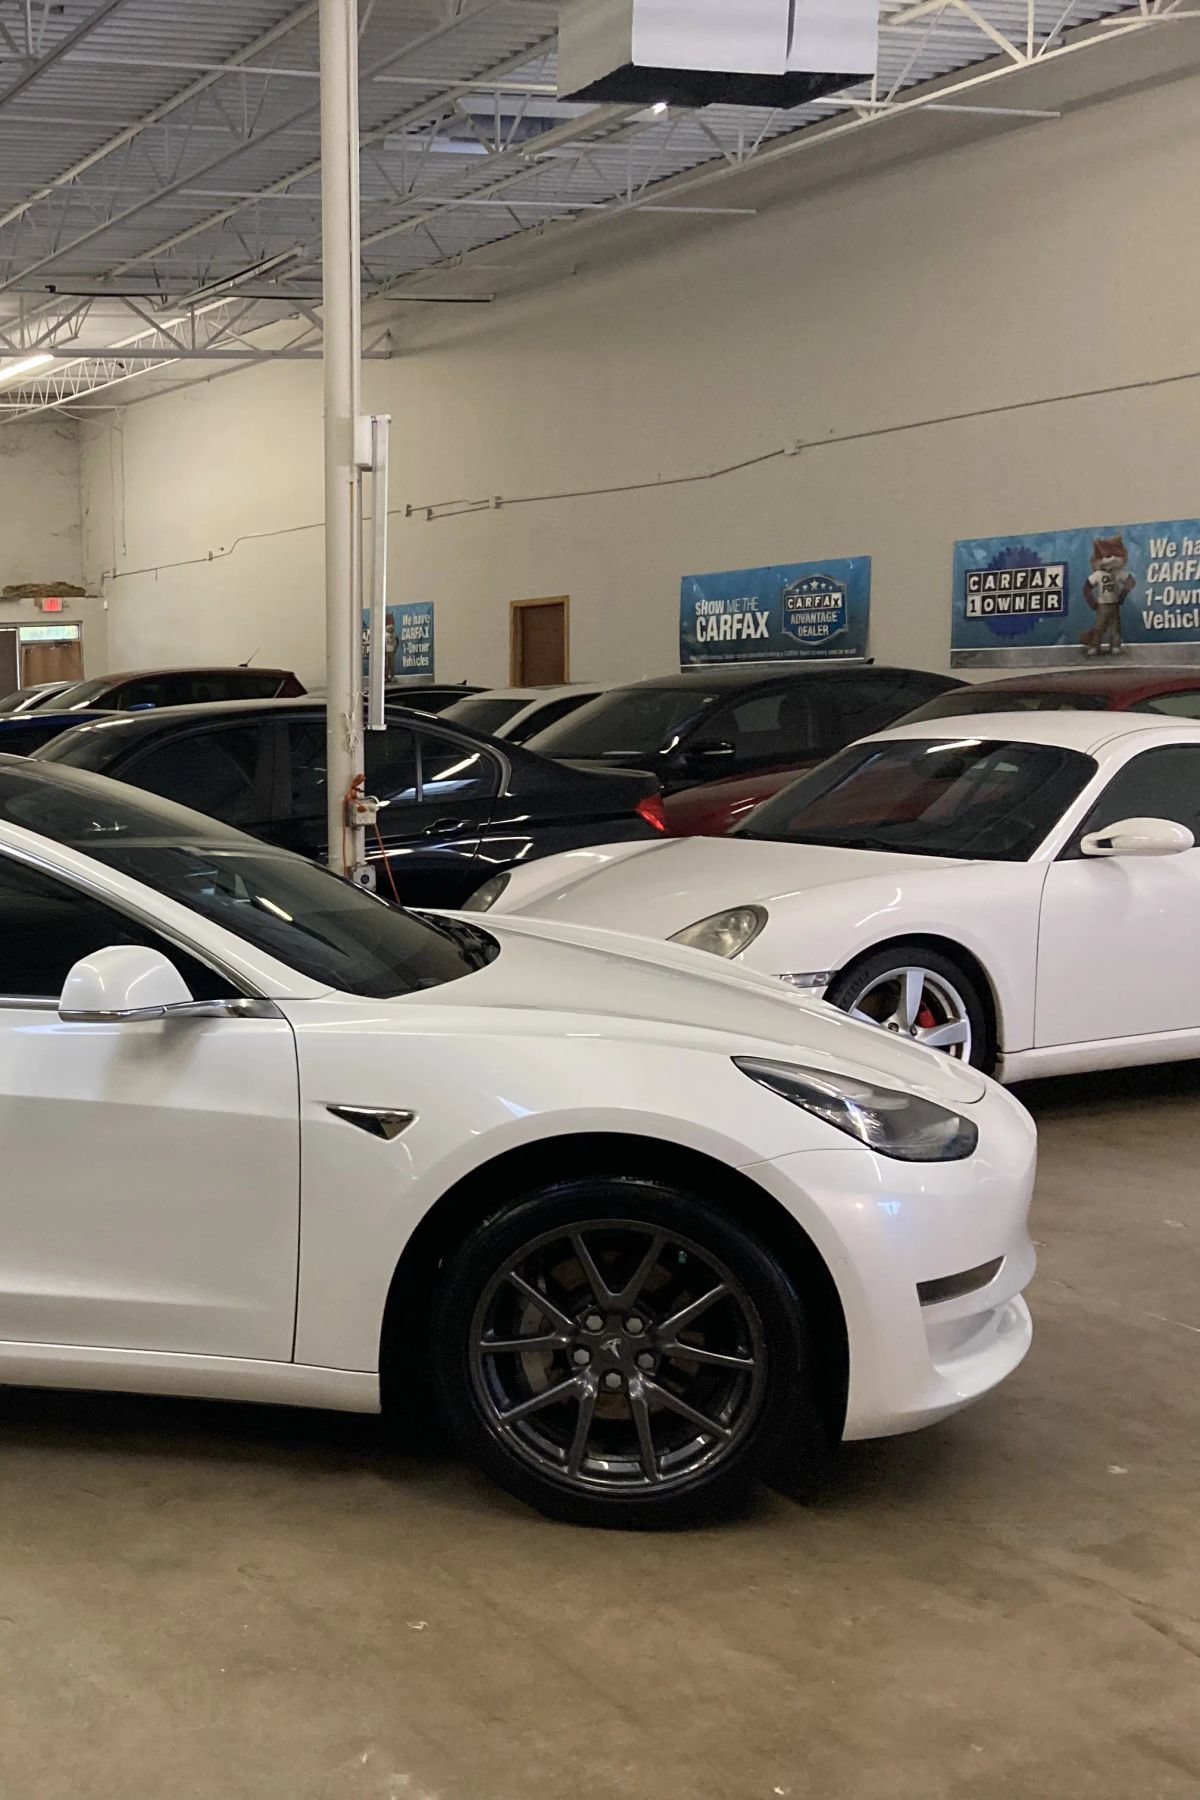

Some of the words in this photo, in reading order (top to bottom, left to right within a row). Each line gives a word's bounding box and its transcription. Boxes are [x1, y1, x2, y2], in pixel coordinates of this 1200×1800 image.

[1149, 537, 1177, 558] We
[969, 571, 1060, 591] CARFAX
[787, 596, 842, 610] CARFAX
[969, 598, 977, 613] 1
[983, 594, 1059, 612] OWNER
[1145, 585, 1200, 606] 1-Own
[695, 599, 725, 616] SHOW
[726, 599, 741, 614] ME
[742, 596, 760, 612] THE
[696, 611, 770, 642] CARFAX
[790, 611, 838, 624] ADVANTAGE
[1142, 608, 1200, 629] Vehicl
[401, 625, 430, 640] CARFAX
[798, 625, 830, 637] DEALER
